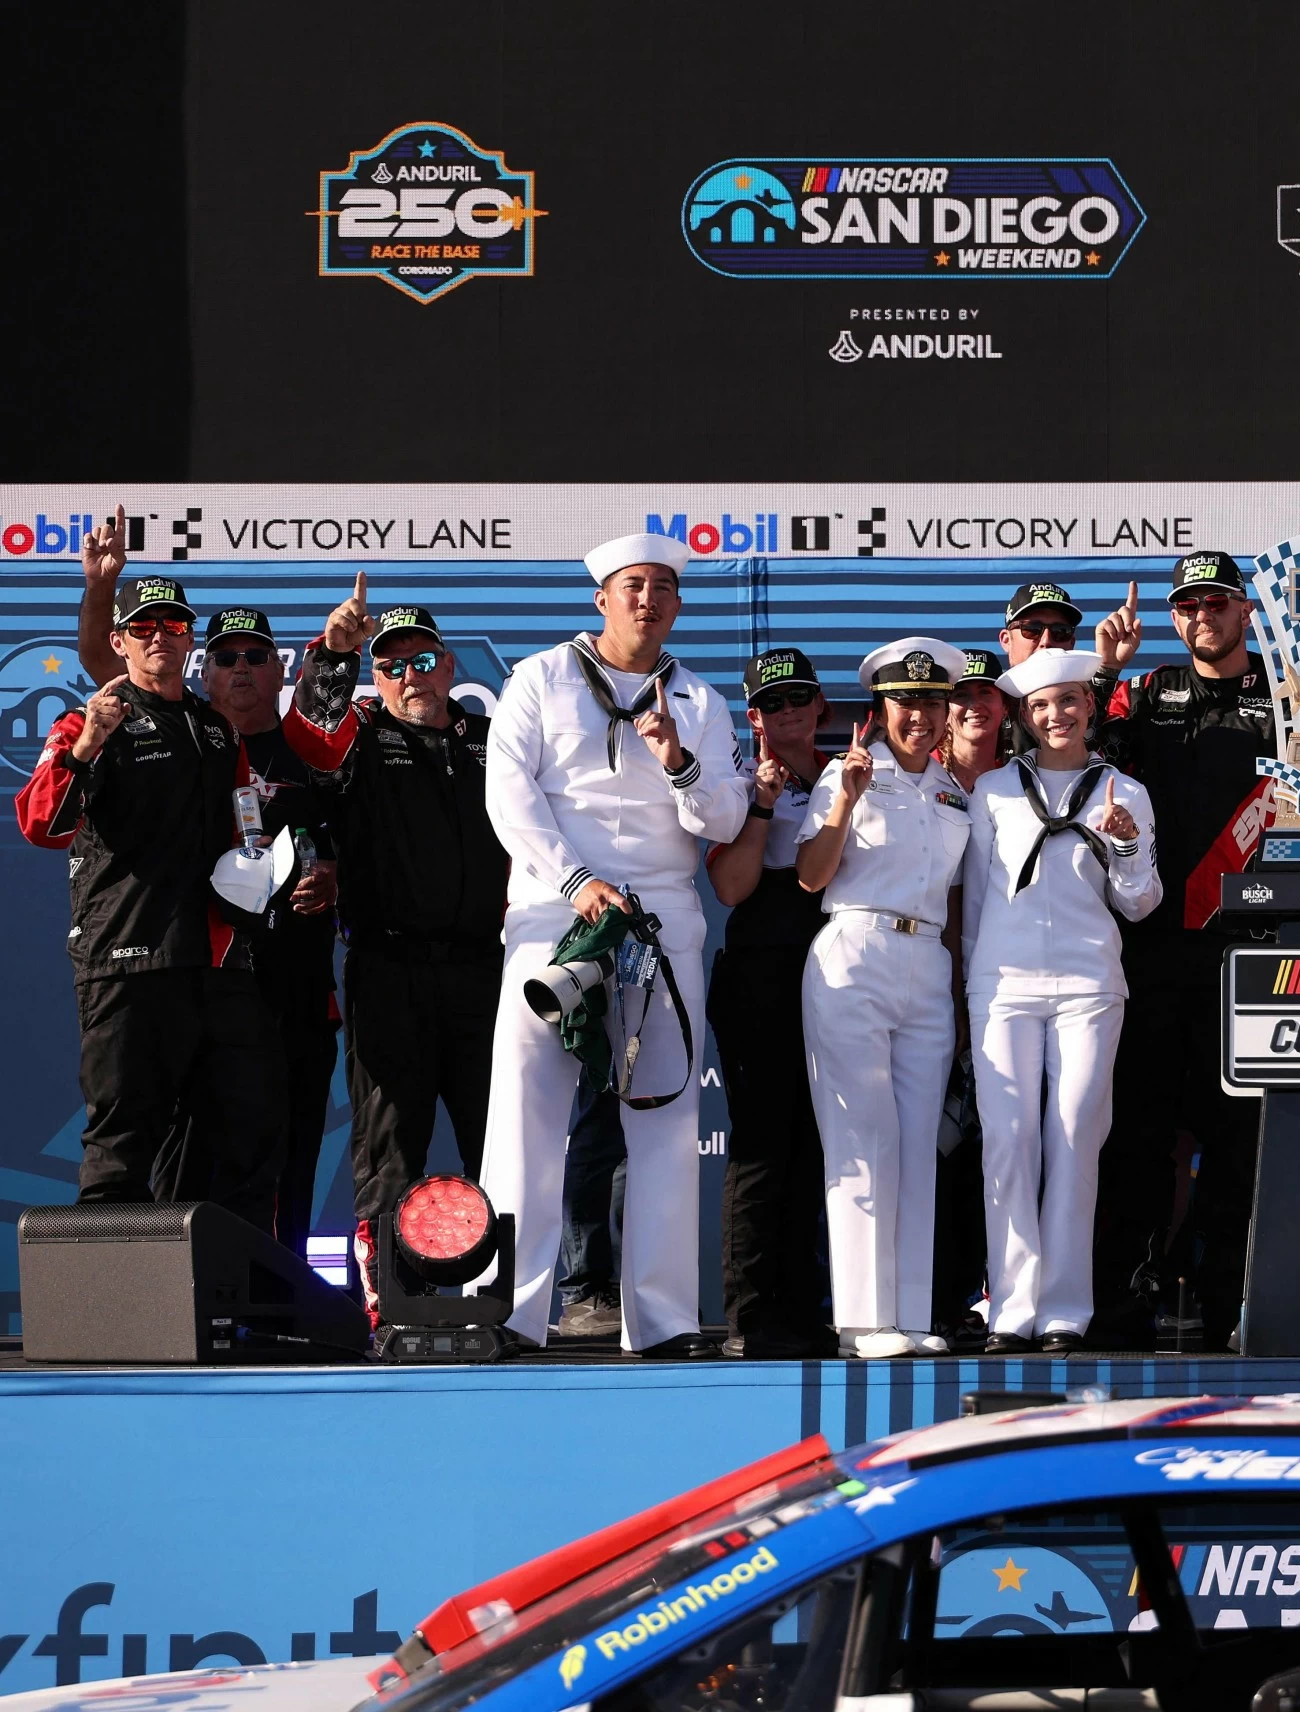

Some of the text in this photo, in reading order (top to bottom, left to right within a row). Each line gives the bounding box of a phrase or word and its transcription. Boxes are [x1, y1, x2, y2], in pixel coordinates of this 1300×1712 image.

[396, 165, 482, 182] ANDURIL
[836, 167, 949, 193] NASCAR
[338, 188, 514, 238] 250
[801, 196, 1120, 245] SAN DIEGO
[371, 245, 481, 259] RACE THE BASE
[957, 248, 1082, 269] WEEKEND
[398, 266, 453, 275] CORONADO
[850, 309, 979, 320] PRESENTED BY
[868, 334, 1003, 359] ANDURIL
[0, 514, 93, 555] obil
[222, 519, 396, 550] VICTORY
[408, 519, 513, 550] LANE
[907, 518, 1078, 549] VICTORY
[1089, 518, 1194, 548] LANE
[1182, 556, 1220, 570] Anduril
[1183, 565, 1218, 584] 250
[136, 578, 176, 590] Anduril
[1029, 583, 1065, 597] Anduril
[139, 586, 175, 603] 250
[220, 609, 258, 620] Anduril
[380, 606, 419, 624] Anduril
[222, 617, 256, 632] 250
[382, 615, 417, 632] 250
[756, 652, 796, 671] Anduril
[965, 652, 988, 663] duril
[761, 662, 794, 684] 250
[963, 662, 986, 675] 50
[1241, 674, 1258, 688] 67
[454, 719, 467, 737] 67
[466, 743, 487, 751] TOY
[135, 752, 172, 762] GOODYEAR
[1232, 777, 1277, 855] 23X
[1242, 889, 1273, 900] BUSCH
[646, 957, 658, 980] MEDIA
[698, 1131, 725, 1155] ull
[594, 1546, 779, 1660] Robinhood
